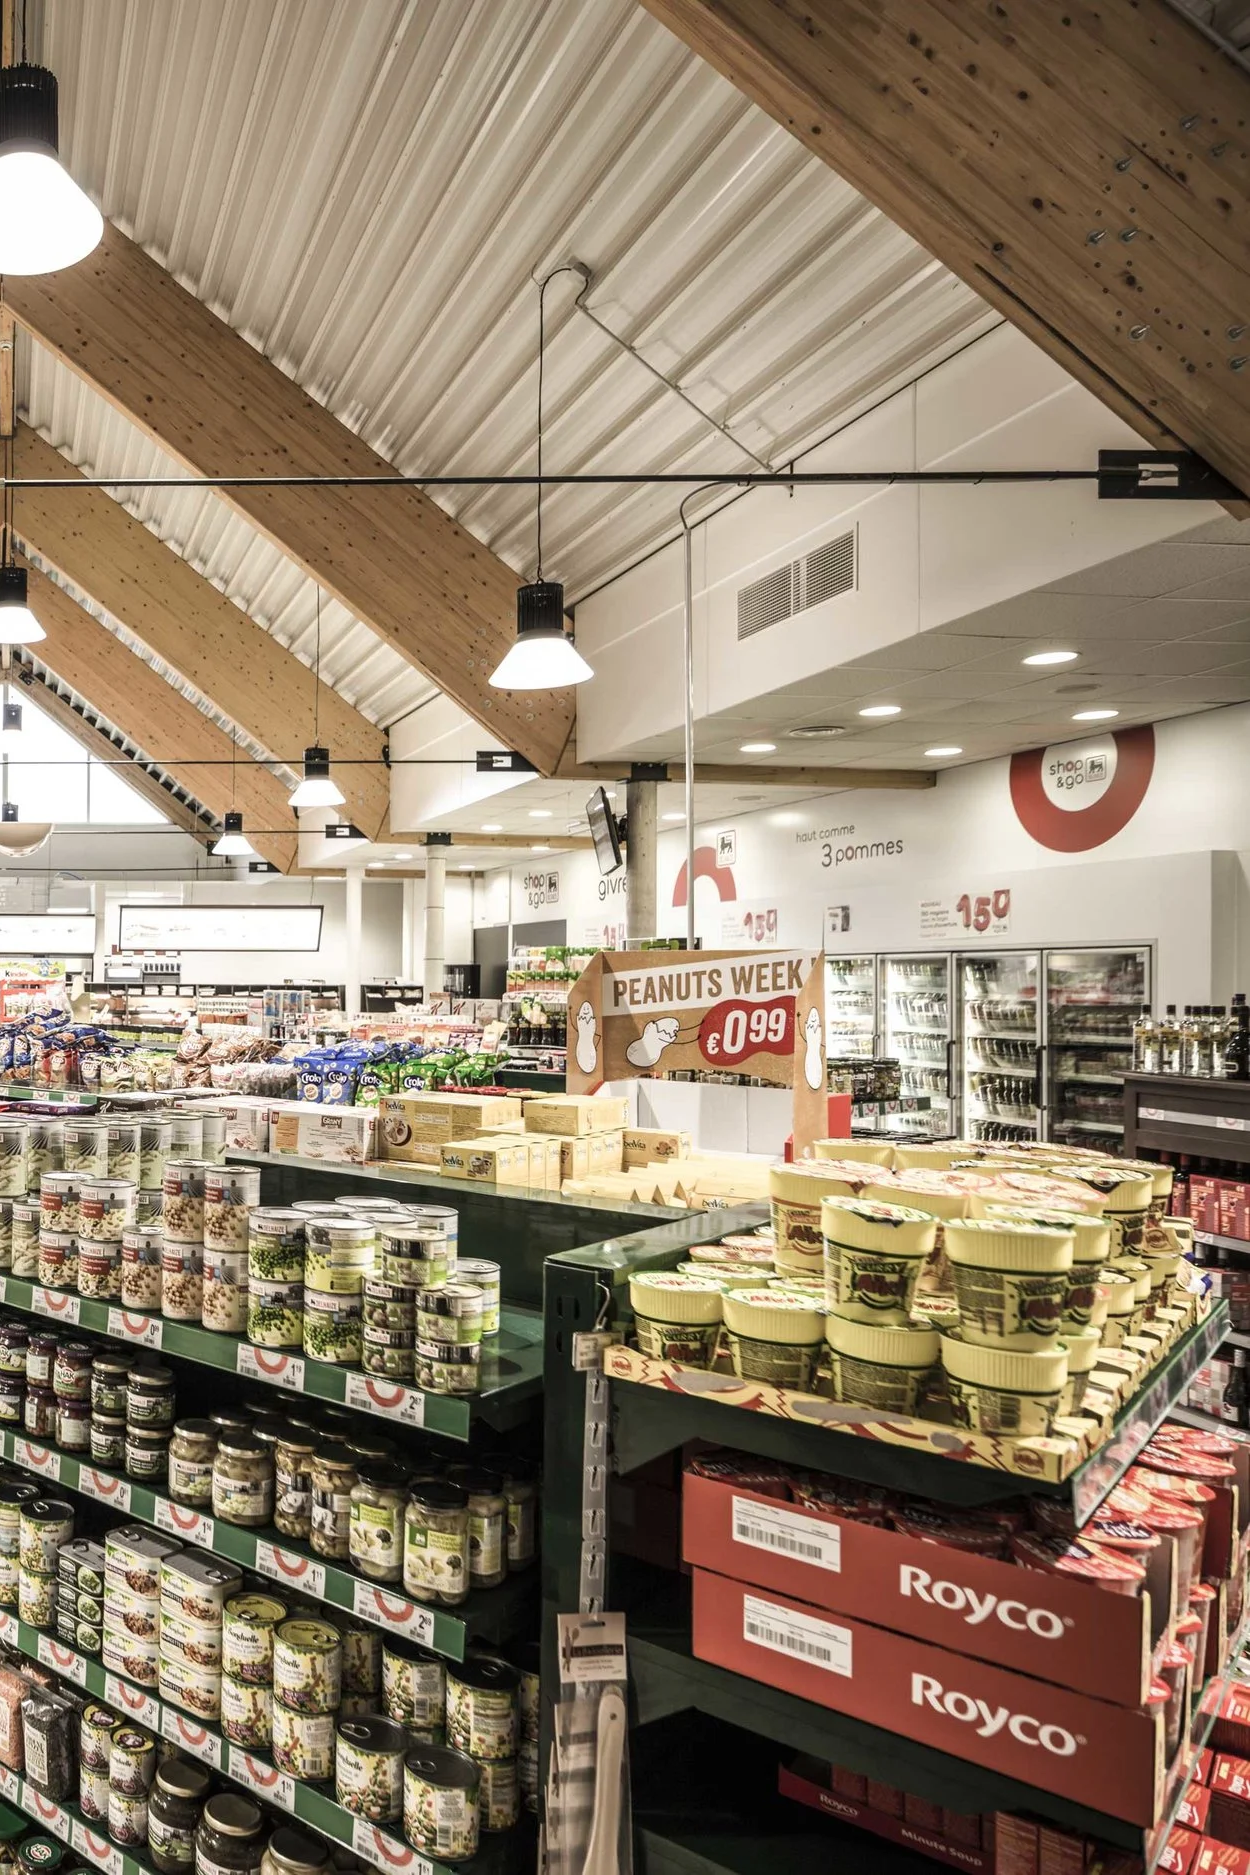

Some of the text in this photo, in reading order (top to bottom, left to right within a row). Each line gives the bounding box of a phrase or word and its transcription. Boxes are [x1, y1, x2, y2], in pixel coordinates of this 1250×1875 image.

[1049, 758, 1084, 776] shop
[1056, 773, 1084, 789] &go
[795, 824, 856, 844] haut comme
[821, 839, 904, 868] 3 pommes
[523, 871, 546, 890] shop
[527, 890, 546, 909] &go
[613, 957, 803, 1007] PEANUTS WEEK
[899, 1562, 1066, 1640] Royco
[227, 1627, 260, 1645] Bonduelle
[910, 1671, 1078, 1757] Royco
[819, 1793, 860, 1816] Royco
[901, 1827, 984, 1868] Minute Soup
